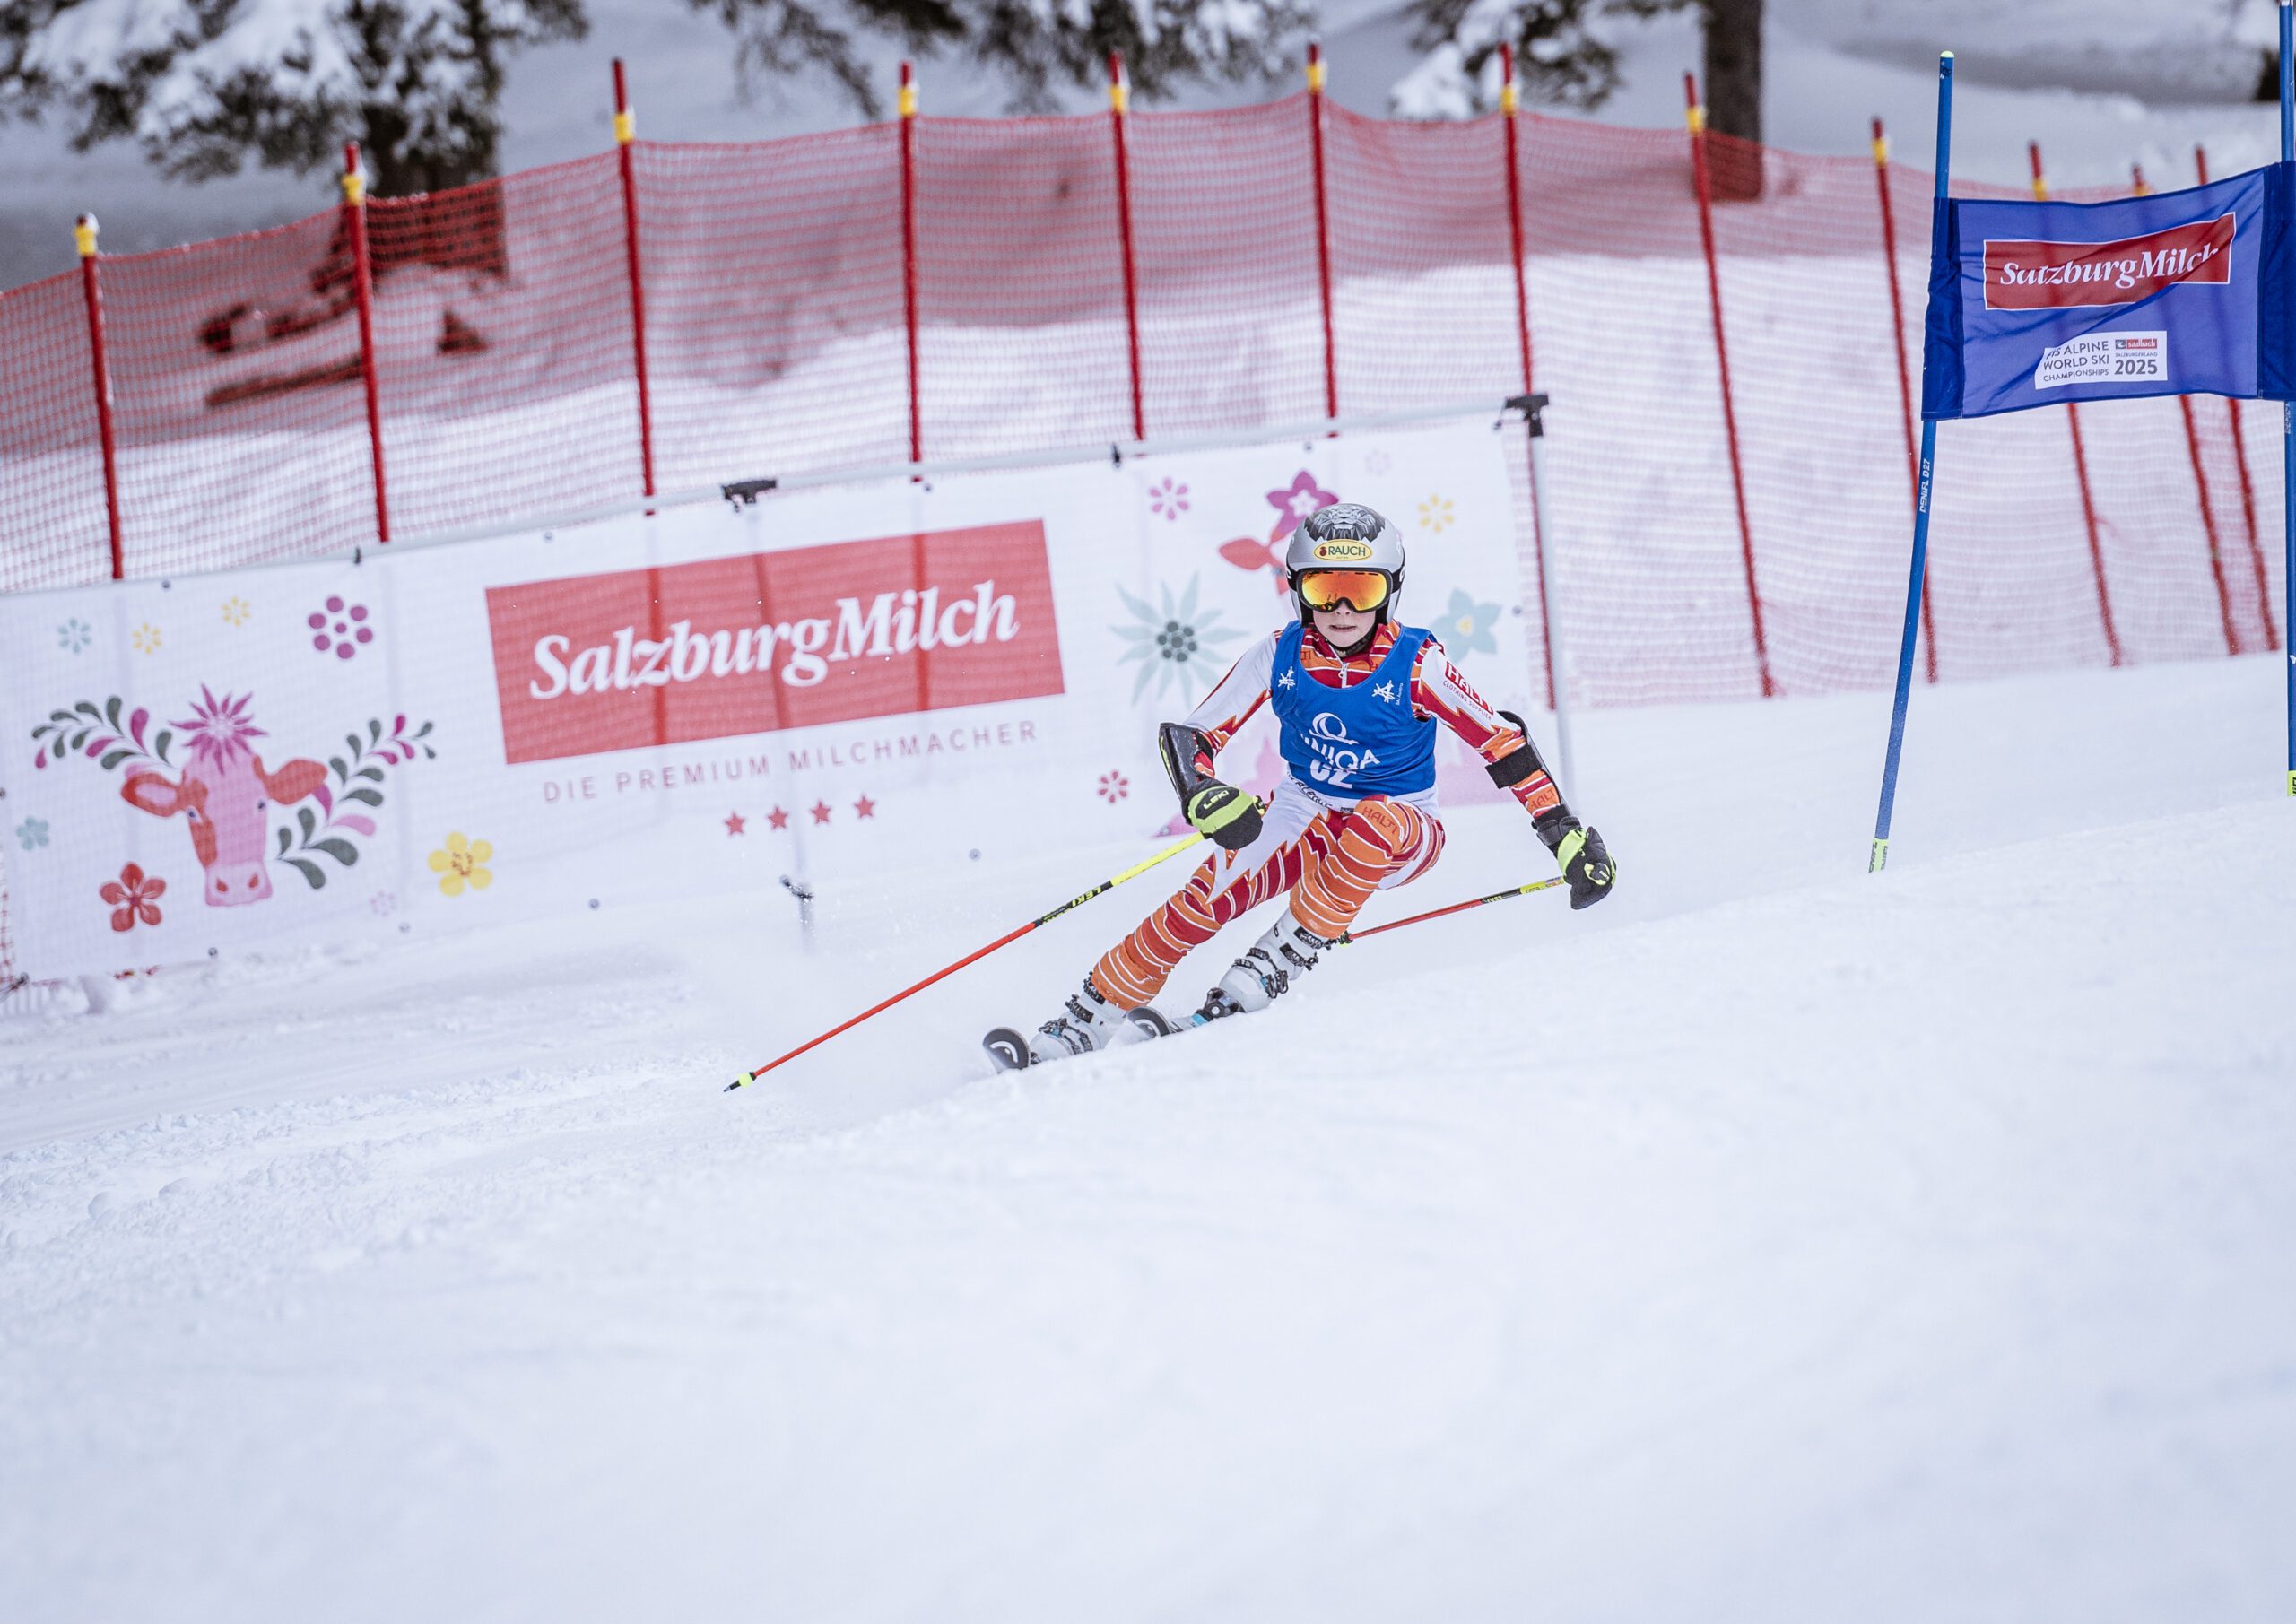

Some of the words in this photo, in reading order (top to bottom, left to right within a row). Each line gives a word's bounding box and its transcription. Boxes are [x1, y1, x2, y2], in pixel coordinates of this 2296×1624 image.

[2064, 341, 2109, 354] ALPINE
[2043, 357, 2088, 370] WORLD
[2092, 354, 2109, 365] SKI
[2114, 359, 2158, 375] 2025
[2043, 369, 2109, 381] CHAMPIONSHIPS
[1922, 458, 1931, 478] D27
[1328, 545, 1366, 556] RAUCH
[530, 579, 1021, 699] SalzburgMilch
[1443, 680, 1467, 702] CLOTHING
[544, 777, 597, 803] DIE
[617, 756, 770, 793] PREMIUM
[790, 721, 1038, 771] MILCHMACHER
[1362, 806, 1398, 834] HALTI
[1071, 886, 1102, 908] LEKI
